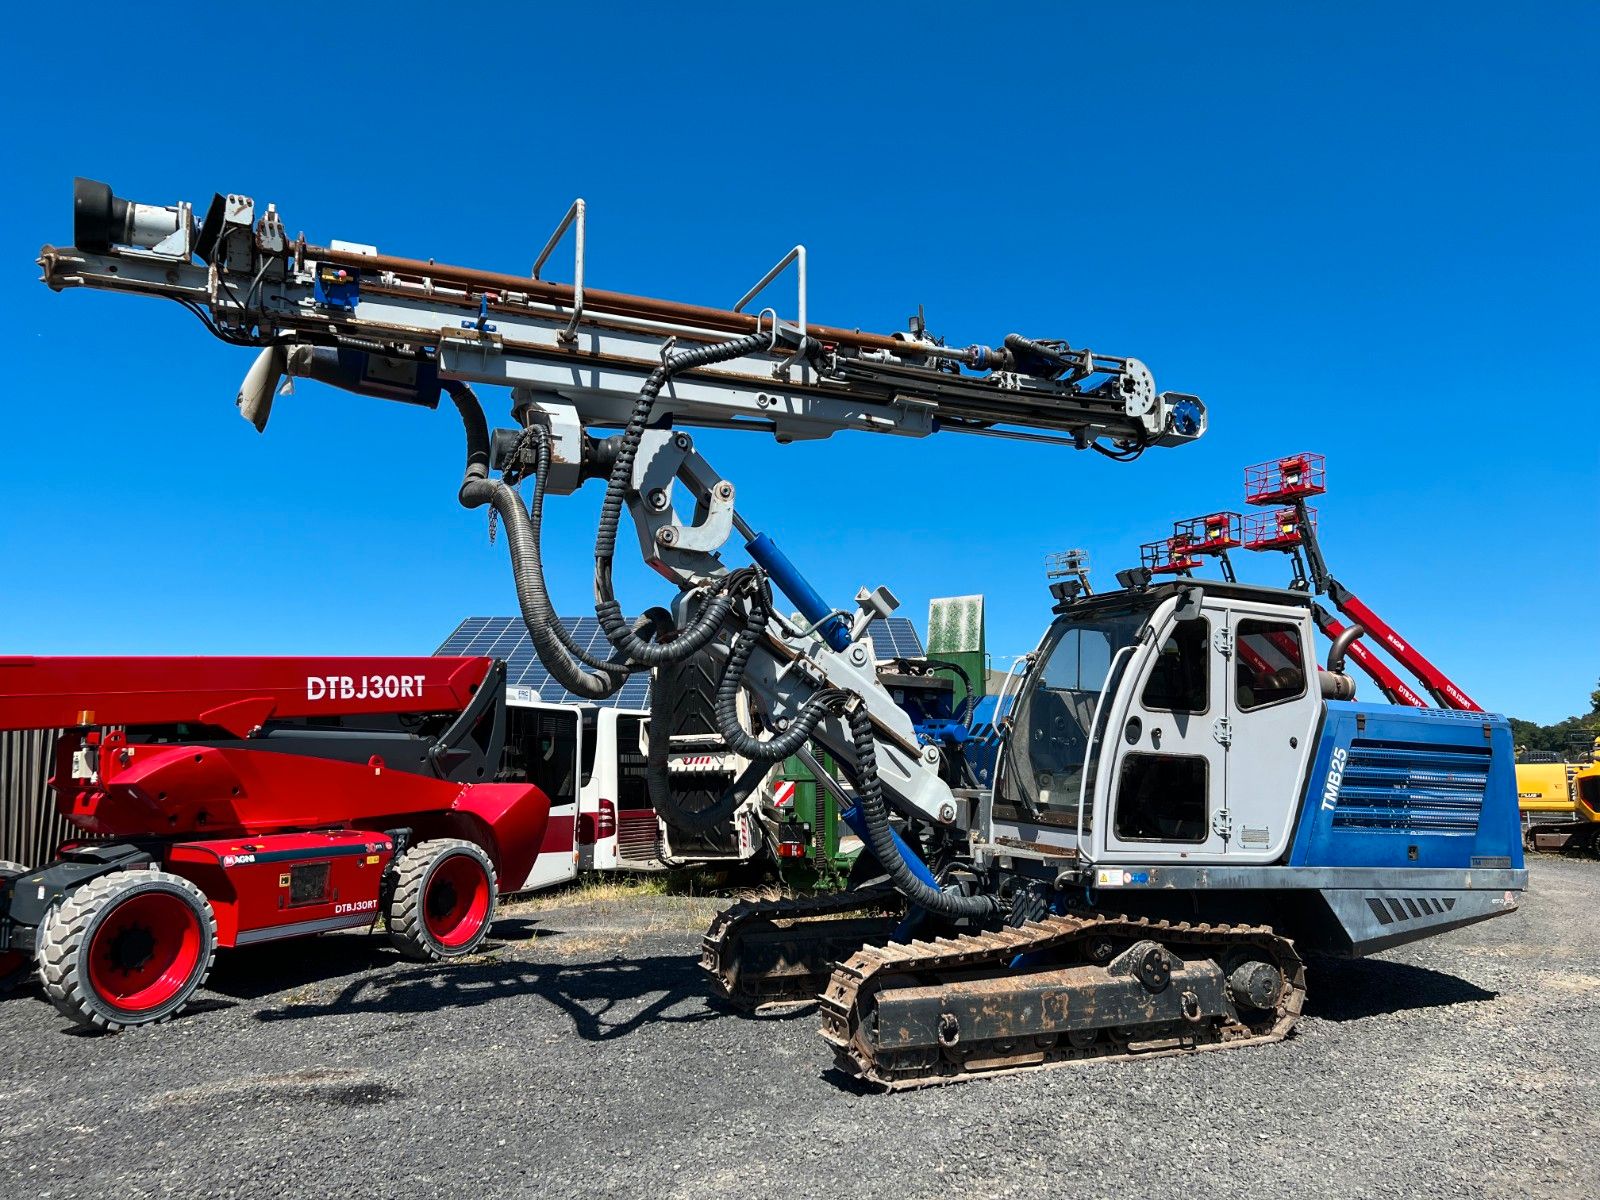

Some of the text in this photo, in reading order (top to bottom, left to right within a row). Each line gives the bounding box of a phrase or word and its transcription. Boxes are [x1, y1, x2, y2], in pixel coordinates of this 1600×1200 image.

[307, 675, 426, 700] DTBJ30RT
[1321, 747, 1347, 811] TMB25
[223, 855, 255, 867] MAGNI
[335, 899, 378, 913] DTBJ30RT
